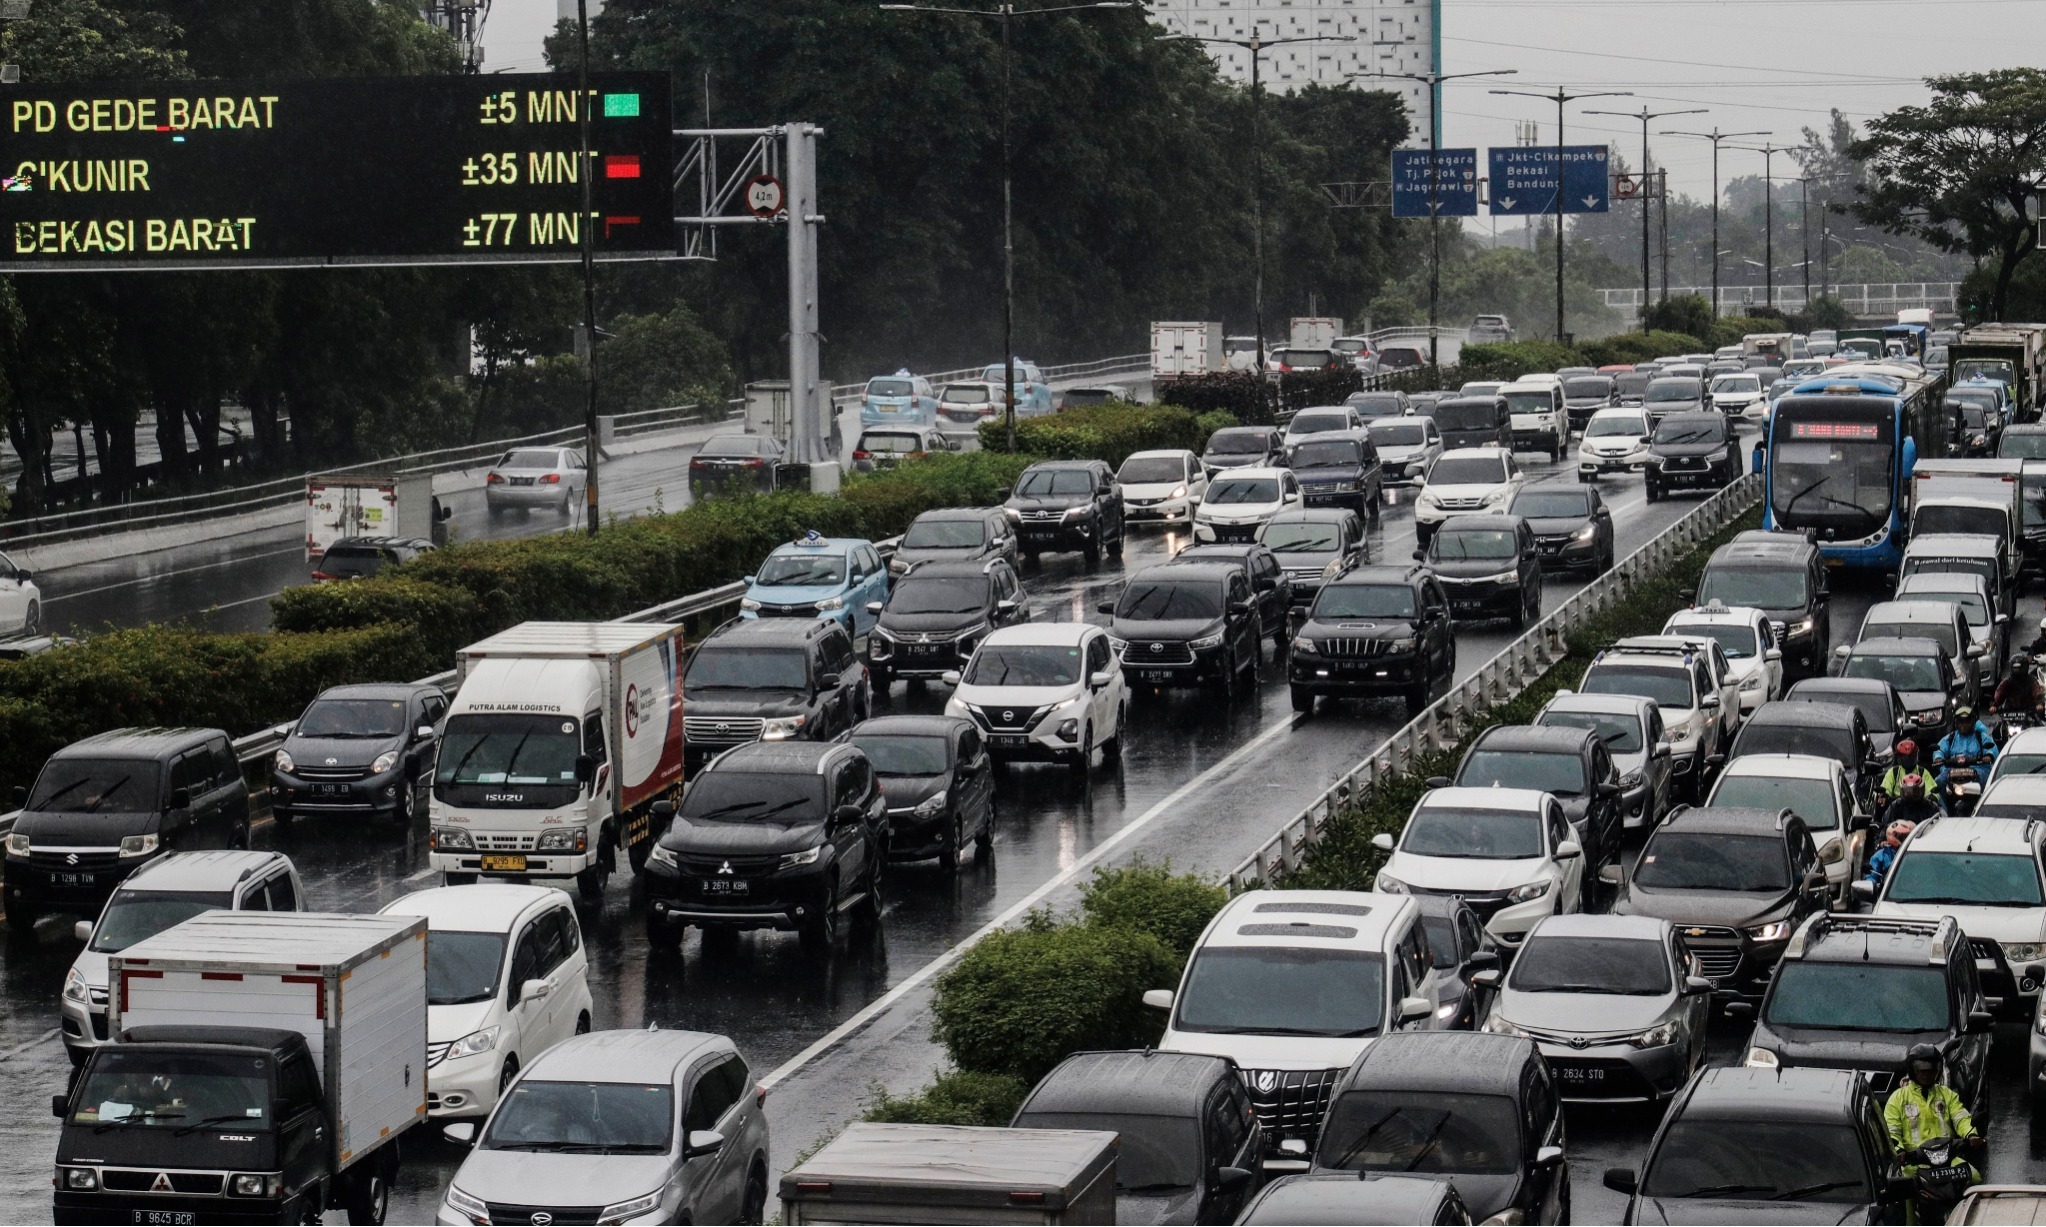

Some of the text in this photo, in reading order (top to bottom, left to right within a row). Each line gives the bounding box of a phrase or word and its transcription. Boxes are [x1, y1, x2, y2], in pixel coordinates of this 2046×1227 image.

[480, 91, 517, 124] ±5
[13, 96, 279, 132] PD GEDE BARAT
[1405, 156, 1473, 167] Jatiegara
[462, 152, 518, 186] ±35
[1507, 166, 1548, 176] Bekasi
[1405, 169, 1420, 181] Tj.
[15, 217, 256, 253] BEKASI BARAT
[463, 212, 518, 247] ±77
[469, 703, 562, 713] PUTRA ALAM LOGISTICS
[485, 794, 523, 802] ISUZU
[483, 856, 488, 865] B
[493, 855, 509, 866] 9295
[51, 874, 56, 882] B
[62, 874, 77, 883] 1298
[704, 881, 709, 890] B
[712, 881, 730, 891] 2673
[1552, 1068, 1558, 1079] B
[1563, 1068, 1584, 1079] 2634
[135, 1211, 193, 1226] B 9645 BCR
